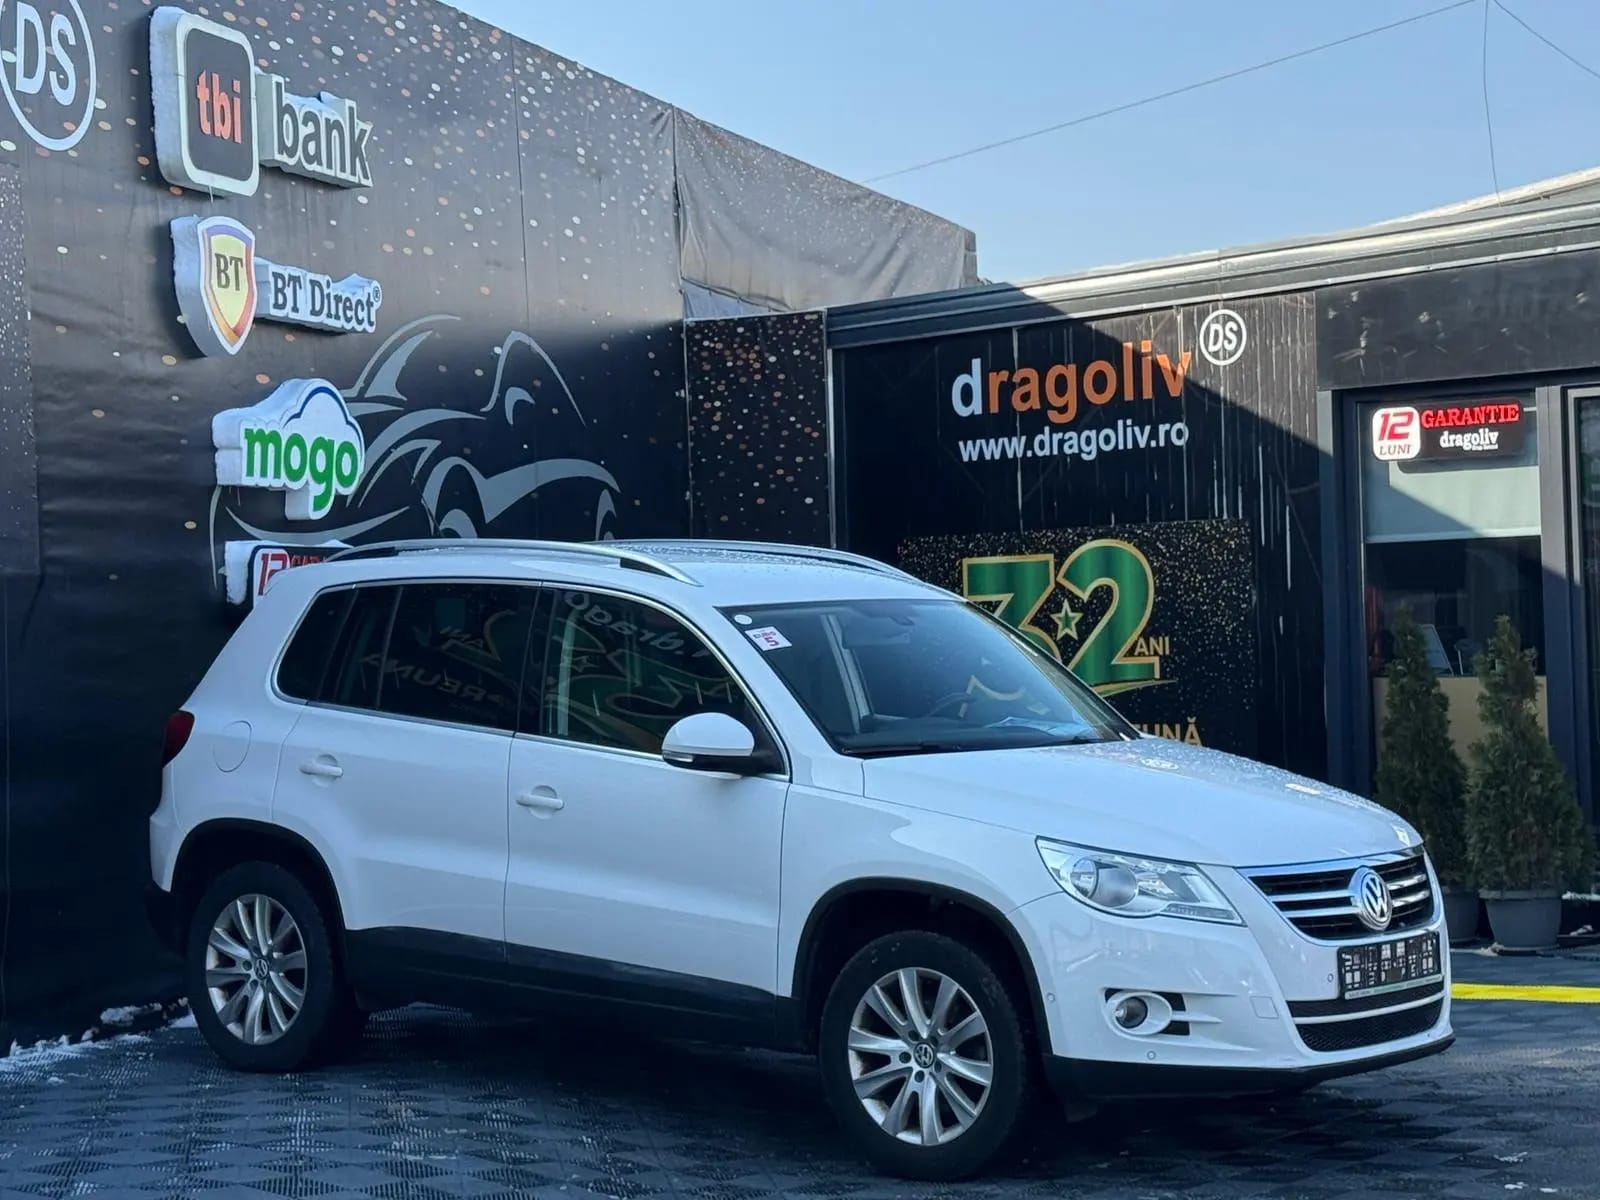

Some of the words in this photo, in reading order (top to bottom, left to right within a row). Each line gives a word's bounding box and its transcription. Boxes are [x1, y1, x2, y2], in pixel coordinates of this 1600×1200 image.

[16, 1, 77, 106] DS
[196, 69, 243, 145] tbi
[275, 81, 370, 182] bank
[214, 252, 244, 292] BT
[272, 271, 302, 313] BT
[1208, 322, 1239, 353] DS
[951, 339, 1192, 424] dragoliv
[958, 418, 1190, 462] www.dragoliv.ro
[1378, 411, 1414, 441] 12
[1420, 403, 1520, 429] GARANTIE
[1439, 427, 1499, 451] dragoliv
[1379, 443, 1412, 456] LUNI
[244, 428, 358, 513] mogo
[962, 538, 1160, 686] 32
[764, 637, 780, 647] 5
[1134, 636, 1171, 657] ANI
